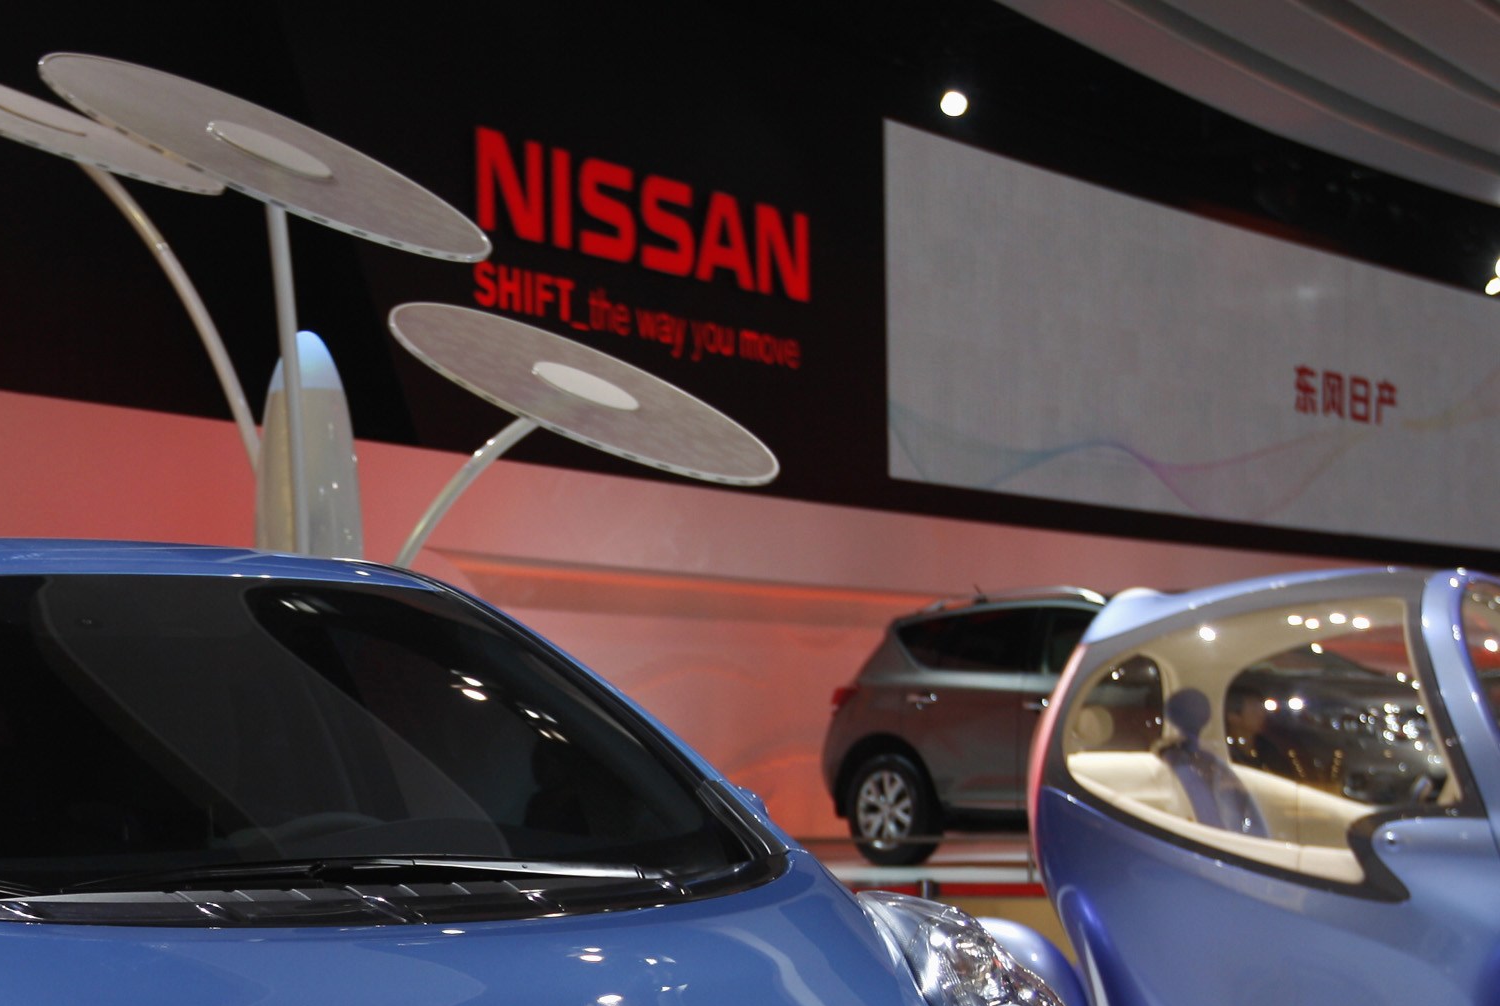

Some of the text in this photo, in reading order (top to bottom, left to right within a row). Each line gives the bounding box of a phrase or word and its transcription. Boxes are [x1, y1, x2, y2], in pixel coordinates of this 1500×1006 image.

[475, 126, 810, 302] NISSAN
[635, 306, 687, 358] way
[691, 320, 735, 362] you
[738, 329, 800, 369] move
[1294, 364, 1397, 426] 东风日产
